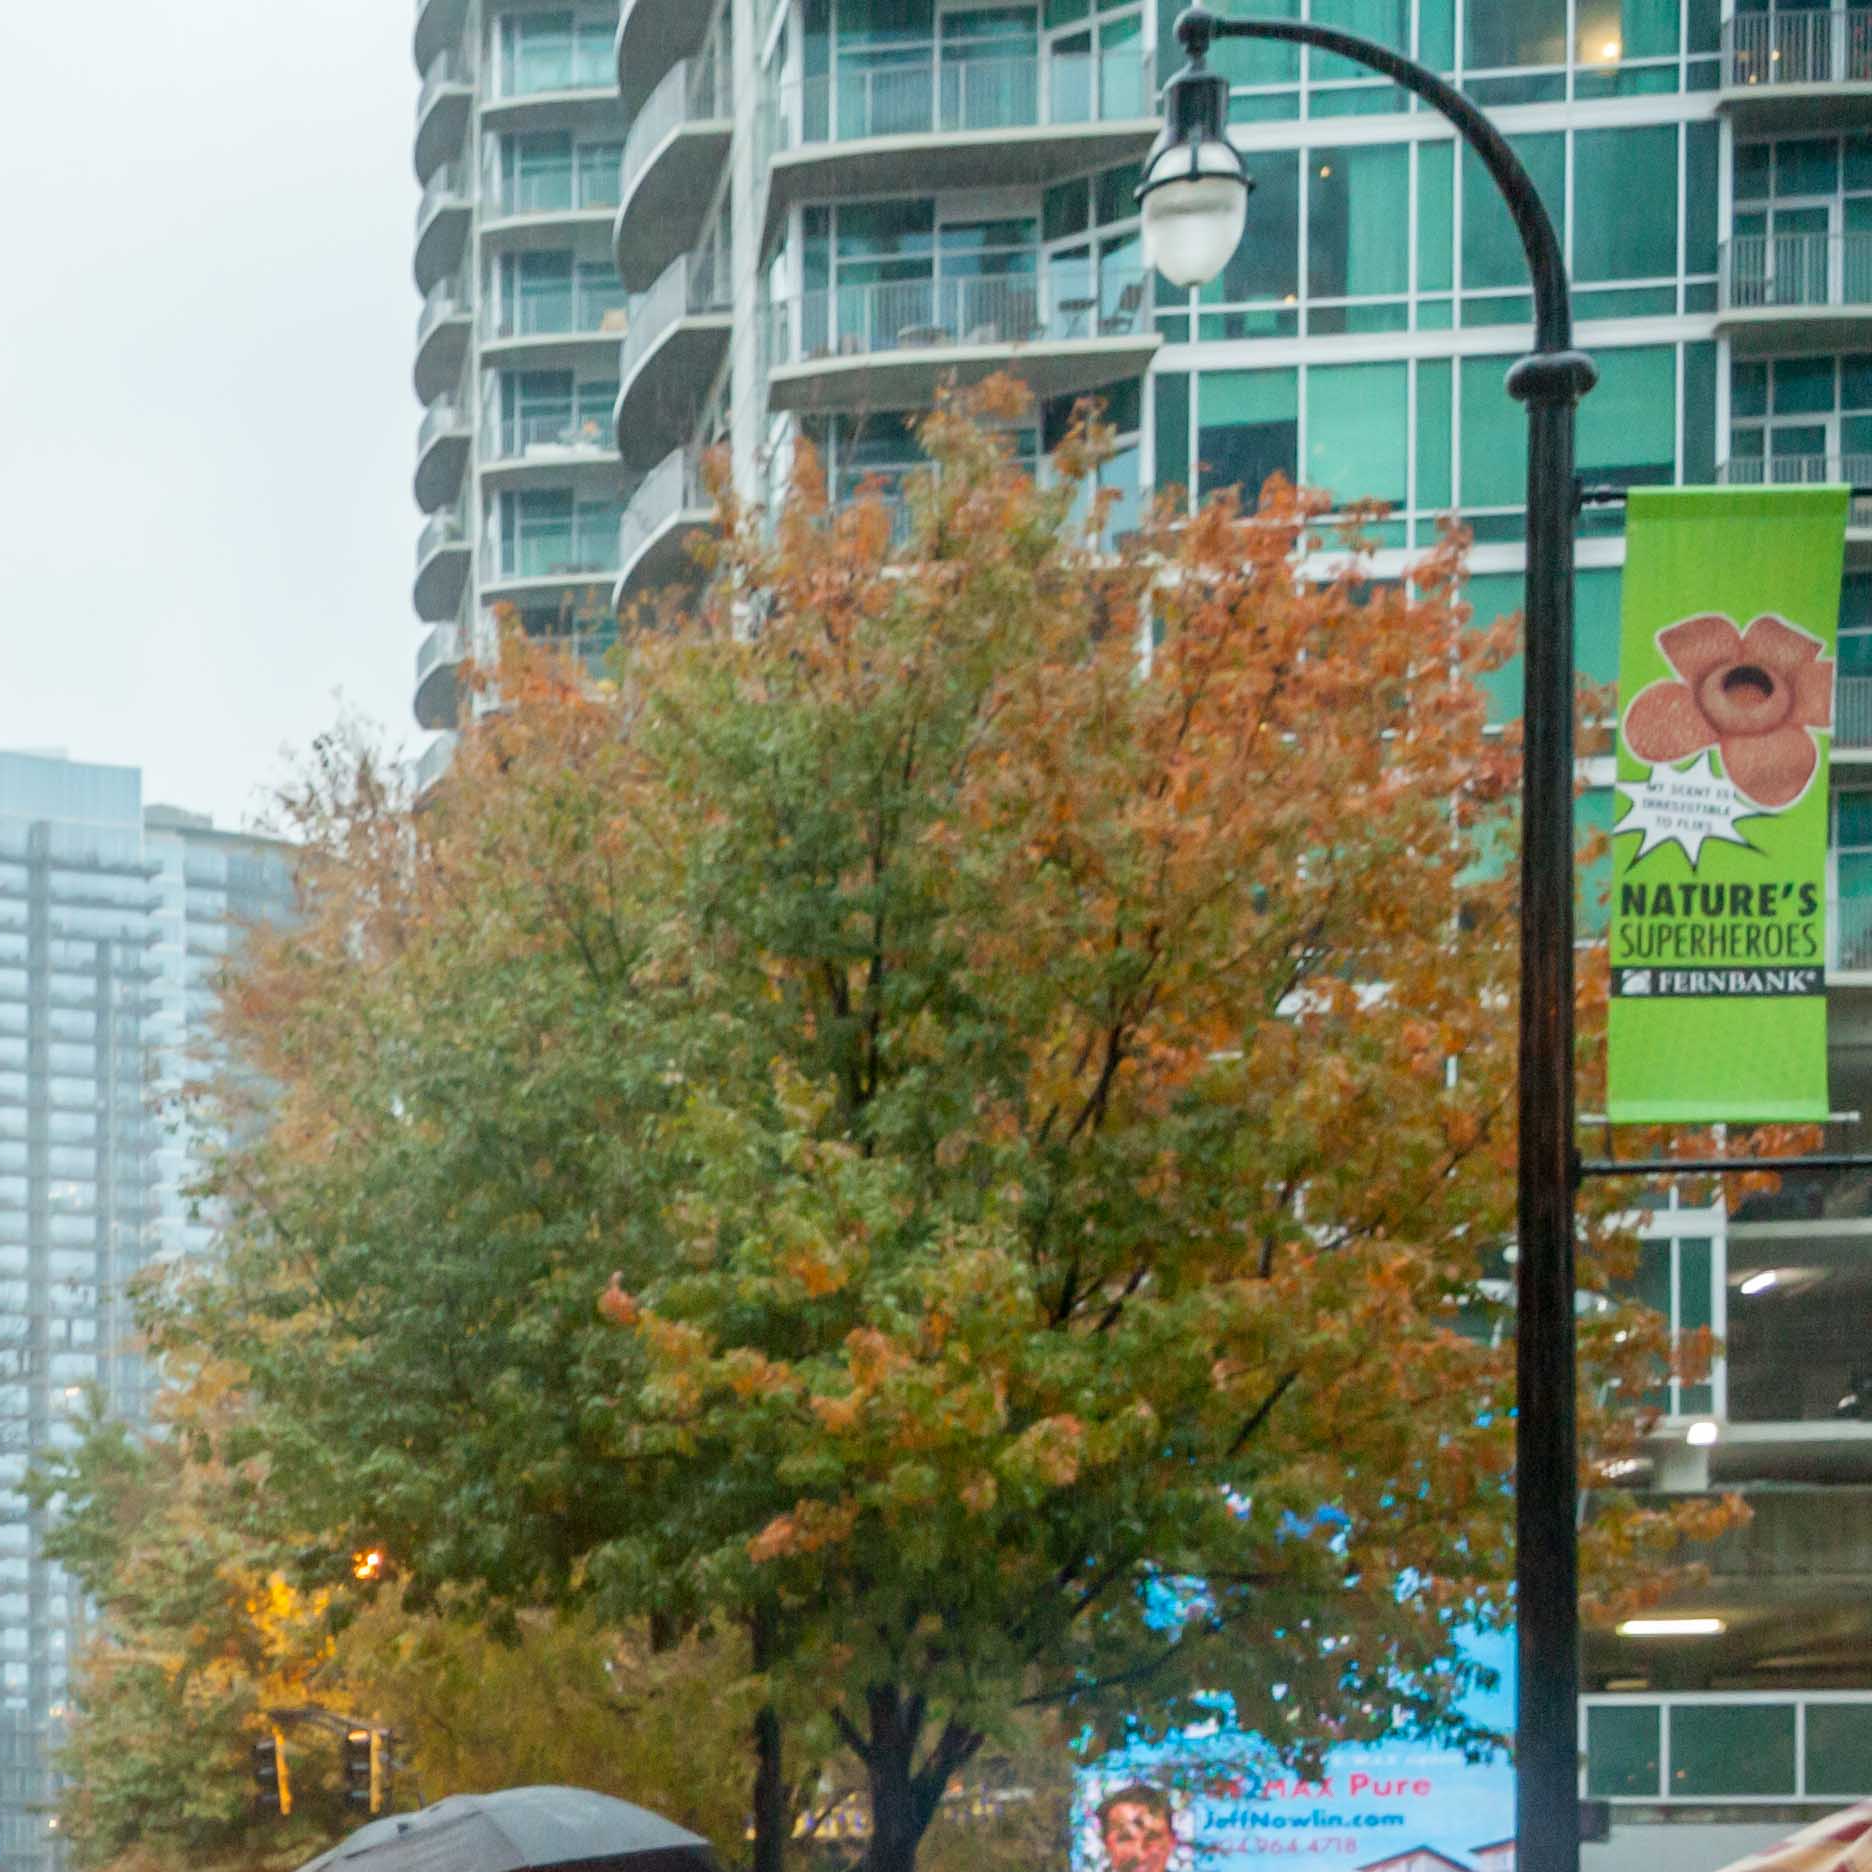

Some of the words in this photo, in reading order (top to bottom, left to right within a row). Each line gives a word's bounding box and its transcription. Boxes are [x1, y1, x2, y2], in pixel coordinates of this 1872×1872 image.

[1620, 883, 1819, 917] NATURE'S
[1619, 922, 1818, 959] SUPERHEROES
[1348, 1772, 1432, 1799] Pure
